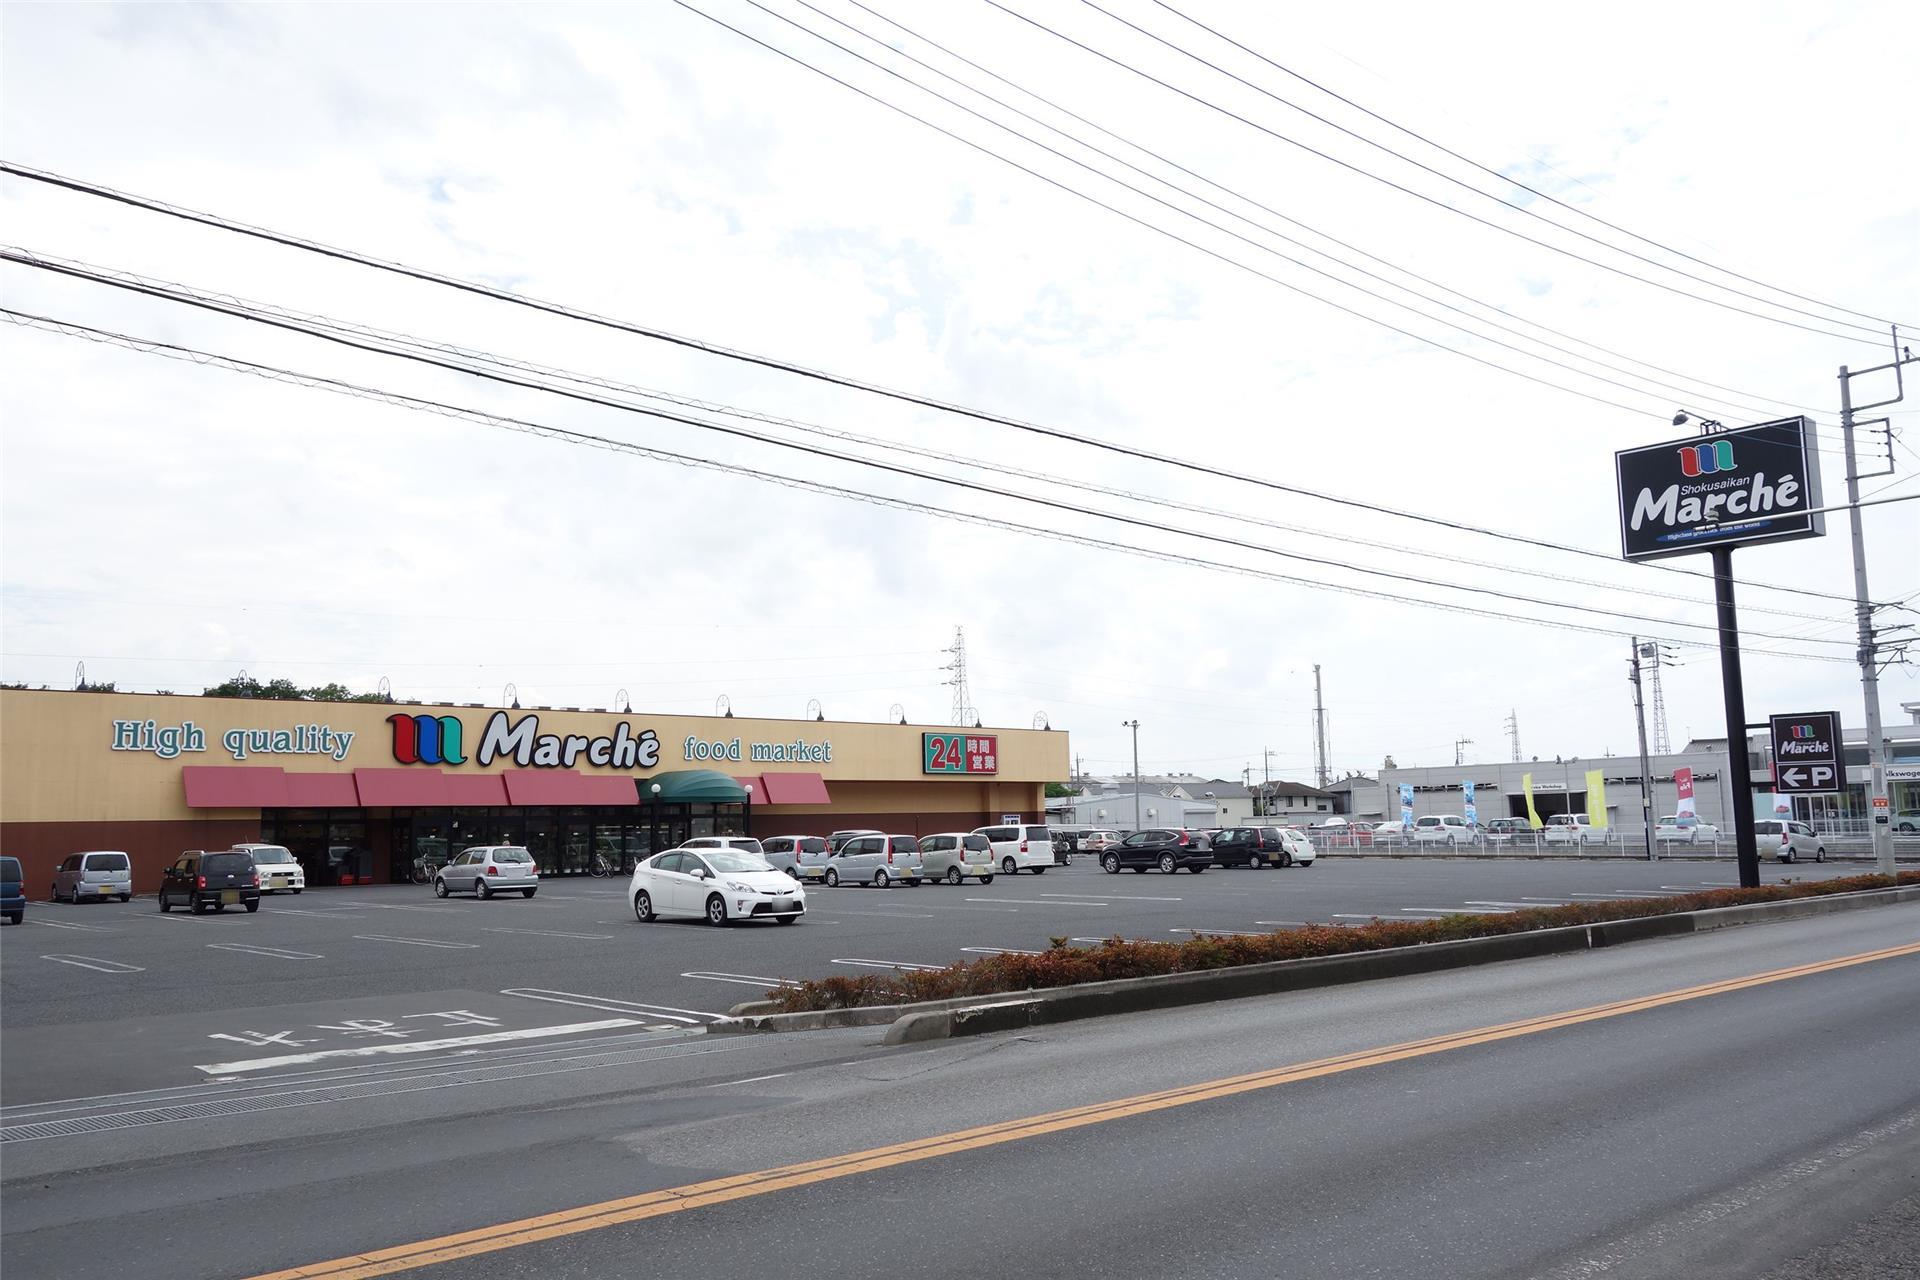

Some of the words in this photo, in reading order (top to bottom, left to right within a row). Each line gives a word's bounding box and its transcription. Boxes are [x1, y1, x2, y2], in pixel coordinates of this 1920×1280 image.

[1681, 477, 1750, 495] Shokusaikan
[1631, 472, 1799, 530] Marché
[113, 719, 206, 758] High
[223, 725, 355, 760] quality
[476, 710, 661, 769] Marché
[685, 735, 741, 760] food
[751, 737, 832, 762] market
[967, 739, 990, 753] 時間
[1781, 741, 1829, 754] Marché
[930, 737, 962, 770] 24
[973, 755, 995, 769] 営業
[1811, 767, 1833, 786] P
